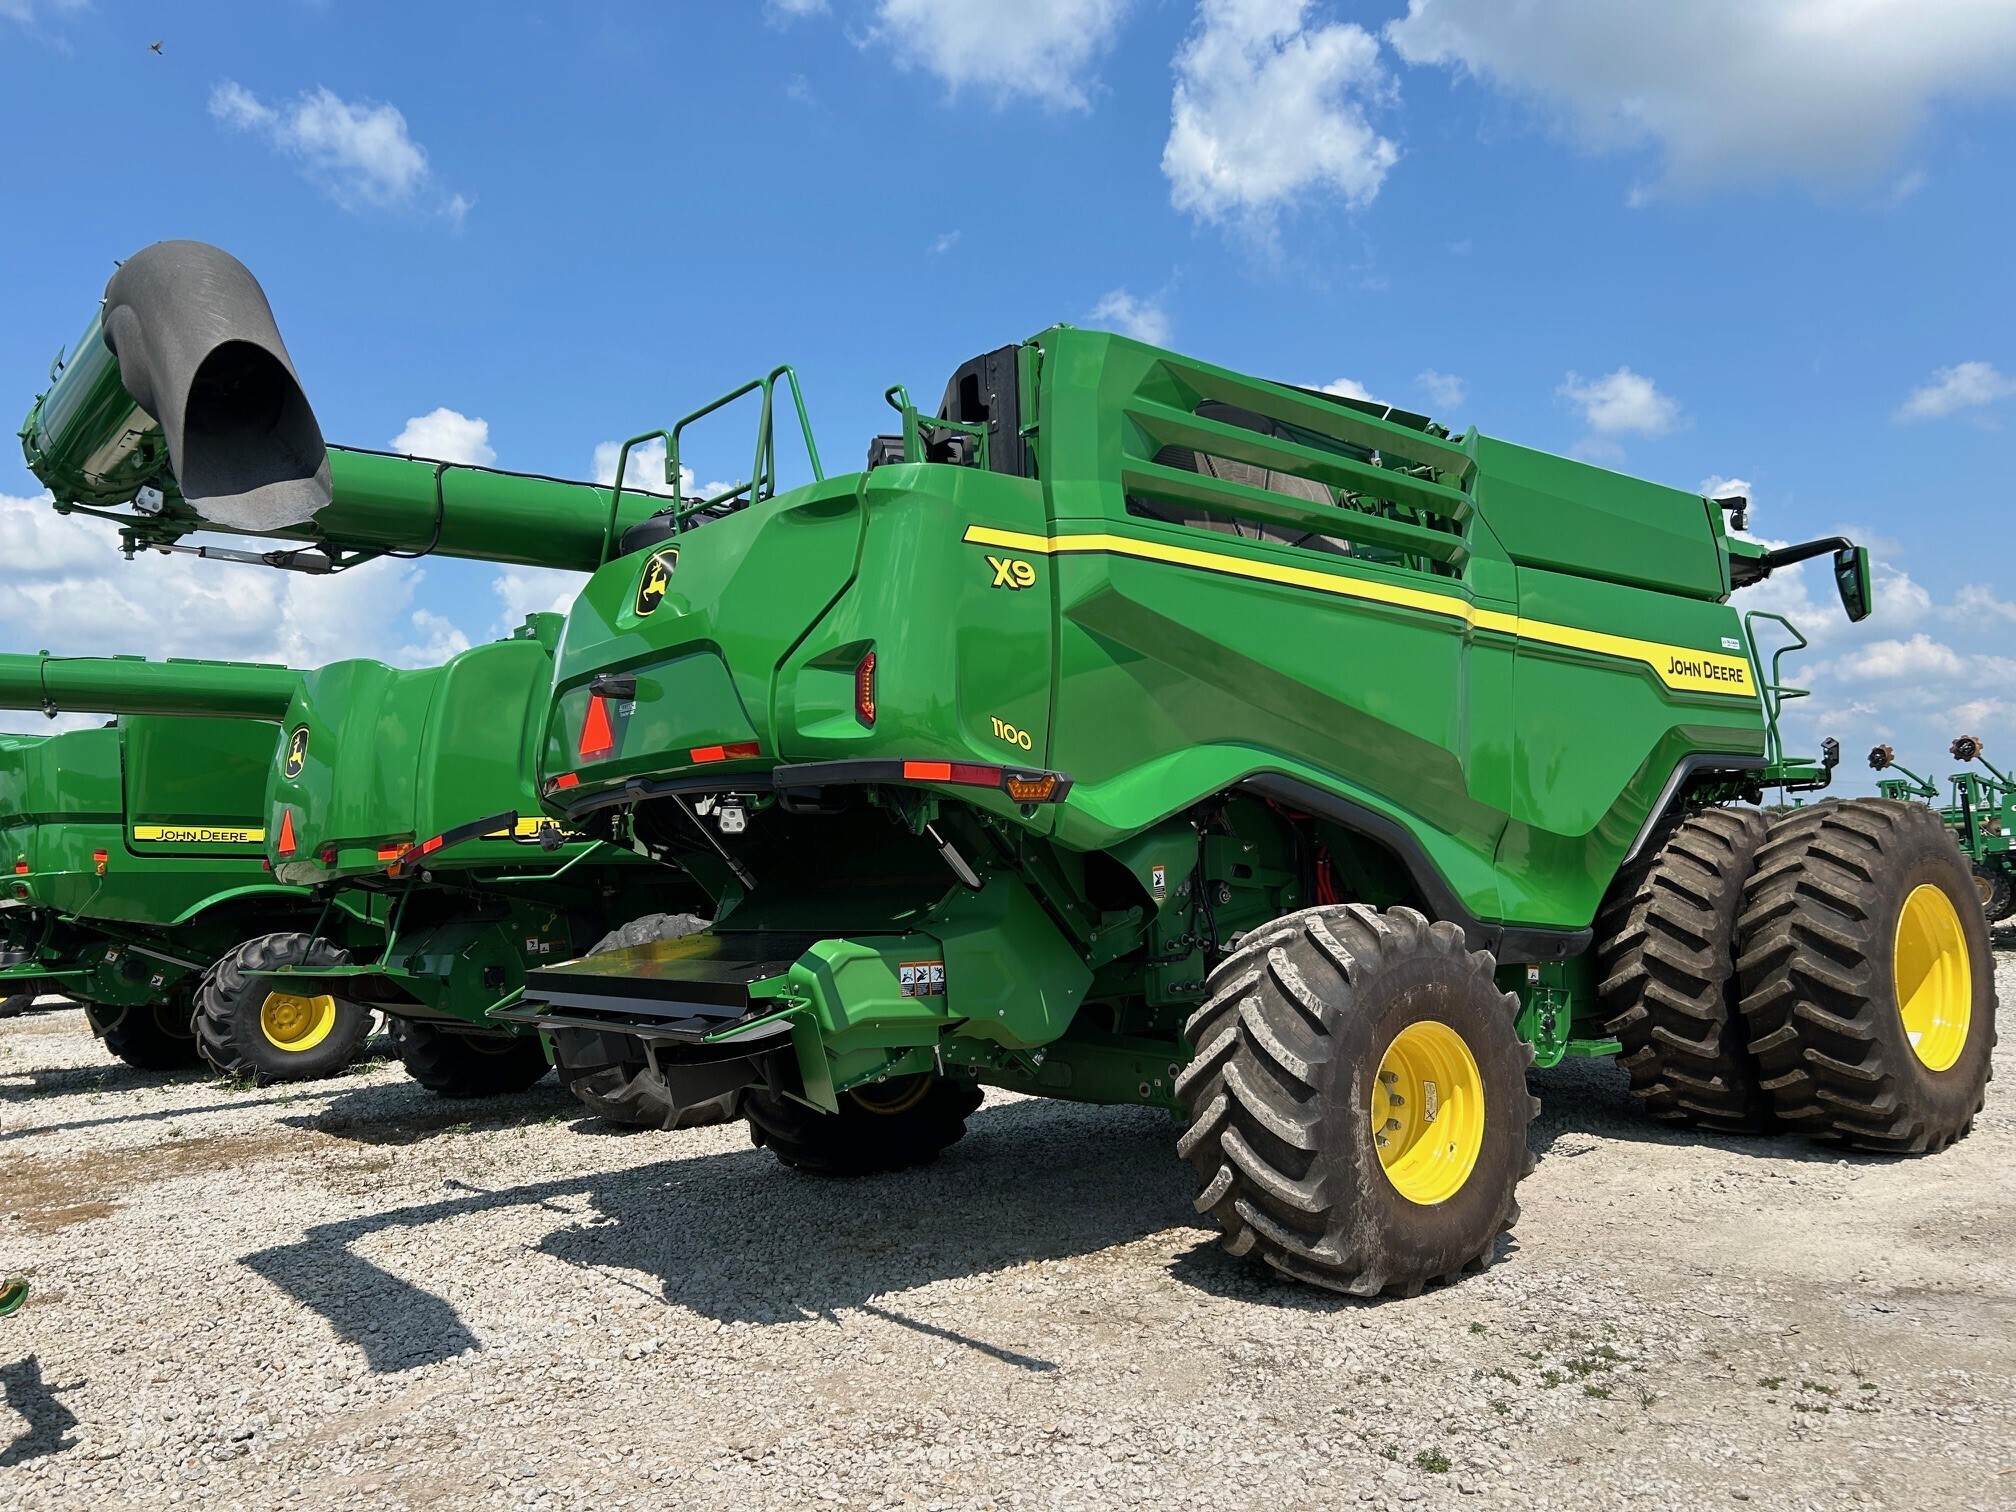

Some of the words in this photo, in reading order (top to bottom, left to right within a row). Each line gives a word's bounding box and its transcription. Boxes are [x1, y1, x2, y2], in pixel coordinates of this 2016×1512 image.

[984, 555, 1036, 590] X9
[1668, 656, 1701, 677] JOHN
[1703, 661, 1744, 683] DEERE
[990, 715, 1032, 751] 1100
[156, 829, 197, 840] JOHN
[200, 830, 248, 841] DEERE
